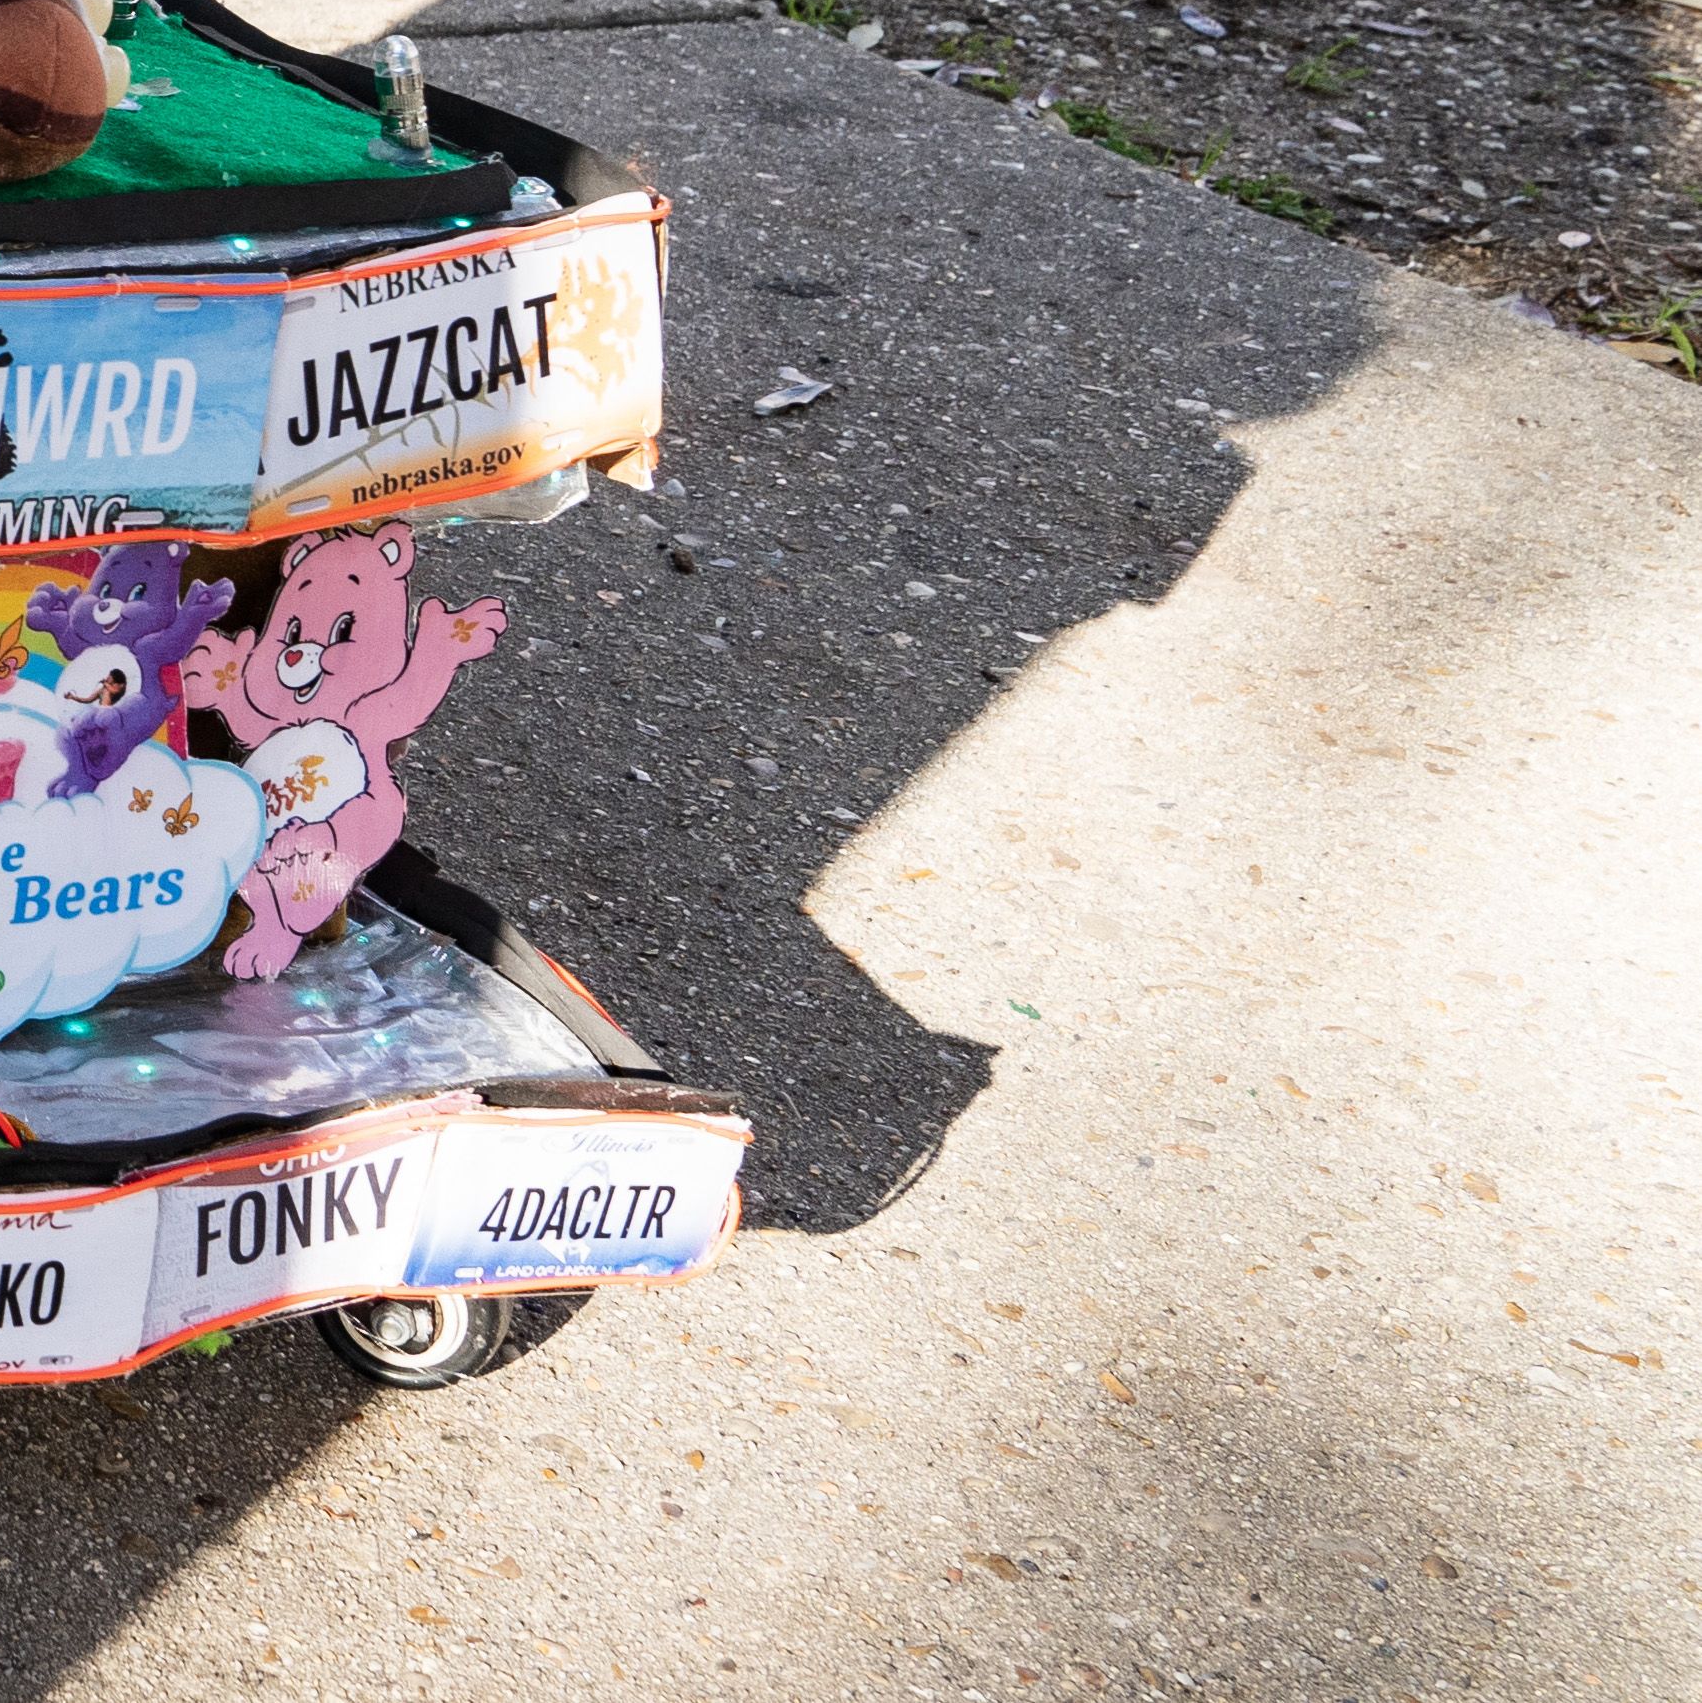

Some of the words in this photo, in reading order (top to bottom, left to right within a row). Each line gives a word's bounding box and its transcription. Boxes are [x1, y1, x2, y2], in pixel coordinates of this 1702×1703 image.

[339, 247, 517, 313] NEBRASKA
[287, 293, 558, 448] JAZZCAT
[351, 442, 526, 505] nebraska.gov
[8, 867, 185, 926] Bears
[196, 1157, 404, 1278] FONKY
[479, 1185, 677, 1242] 4DACLTR
